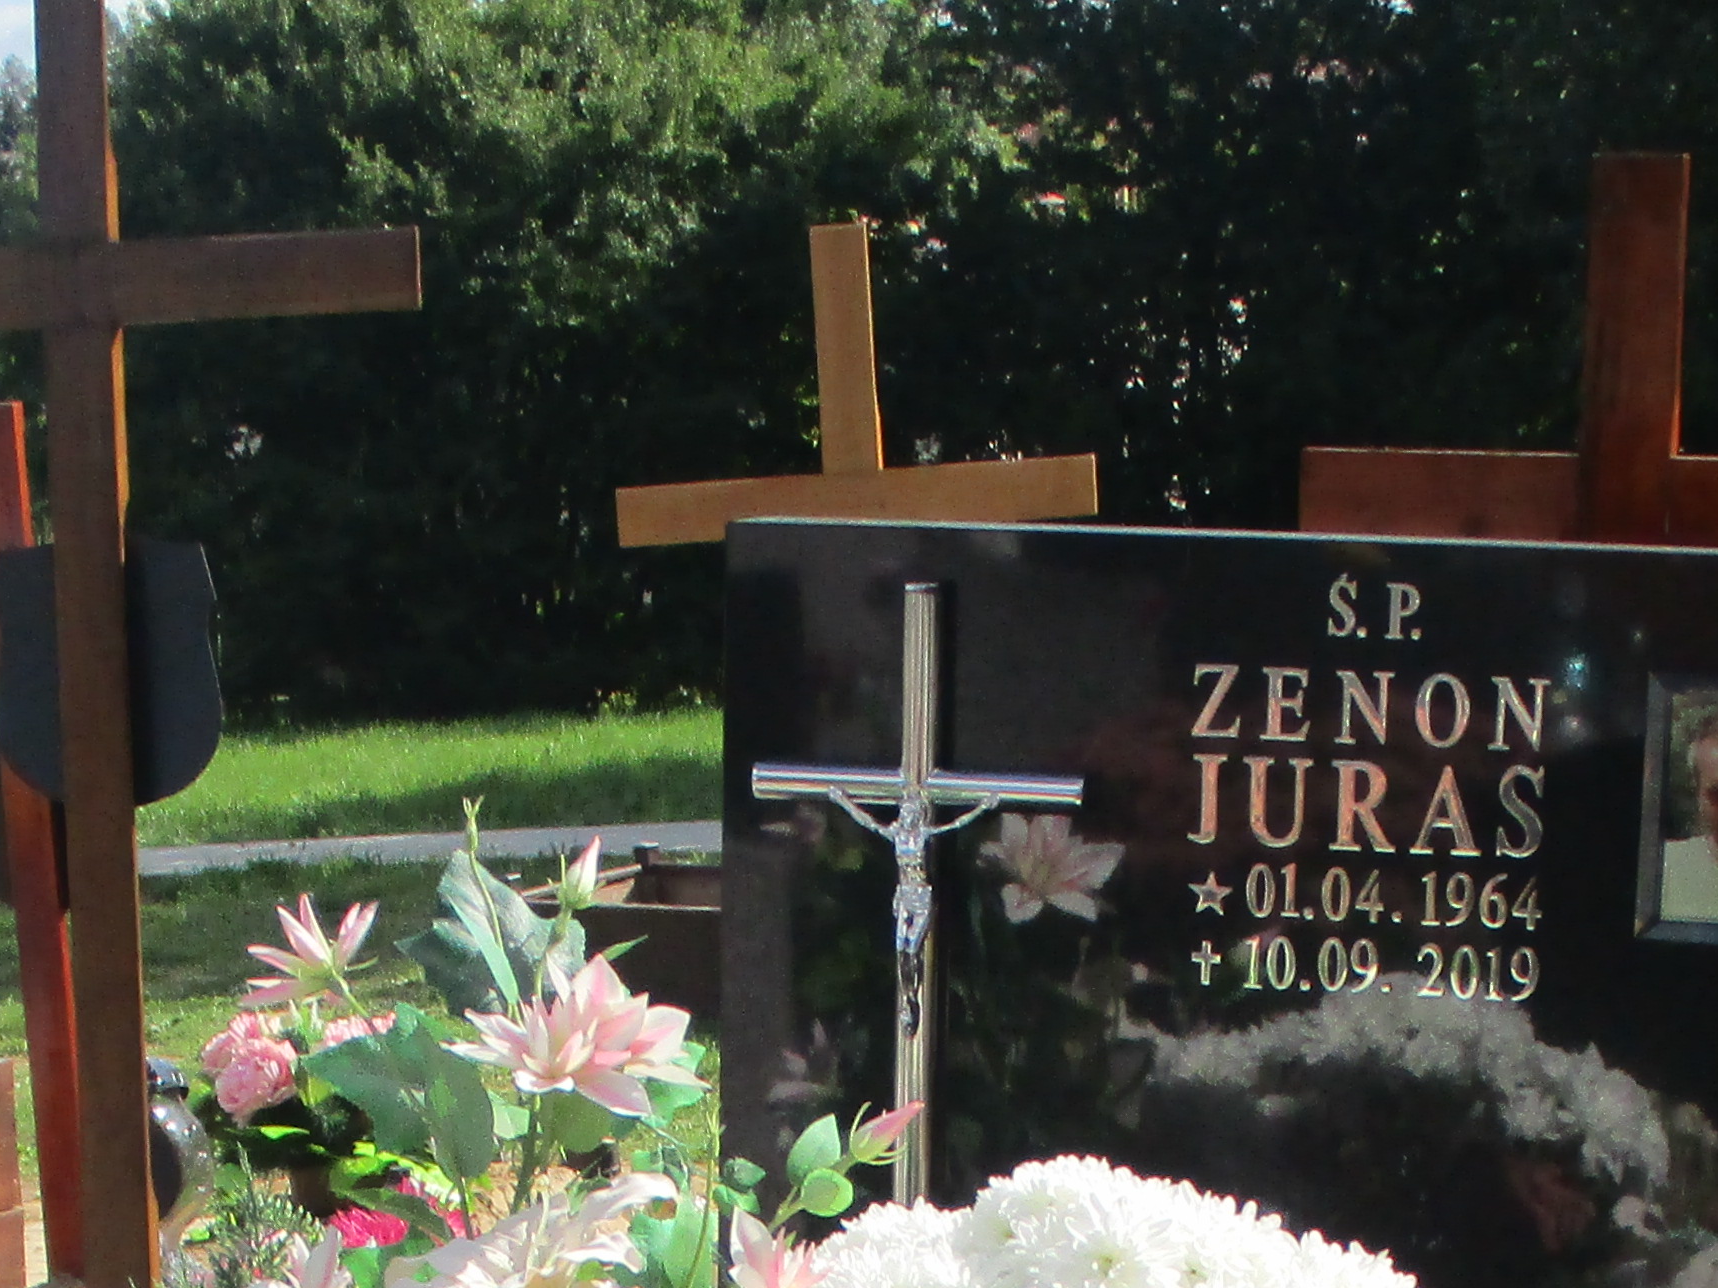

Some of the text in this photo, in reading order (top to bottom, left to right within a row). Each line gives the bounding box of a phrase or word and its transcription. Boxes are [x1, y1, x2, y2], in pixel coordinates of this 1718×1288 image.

[1384, 582, 1422, 641] P.
[1190, 663, 1552, 751] ZENON
[1187, 753, 1546, 858] JURAS
[1420, 870, 1543, 931] 1964
[1417, 942, 1540, 1001] 2019
